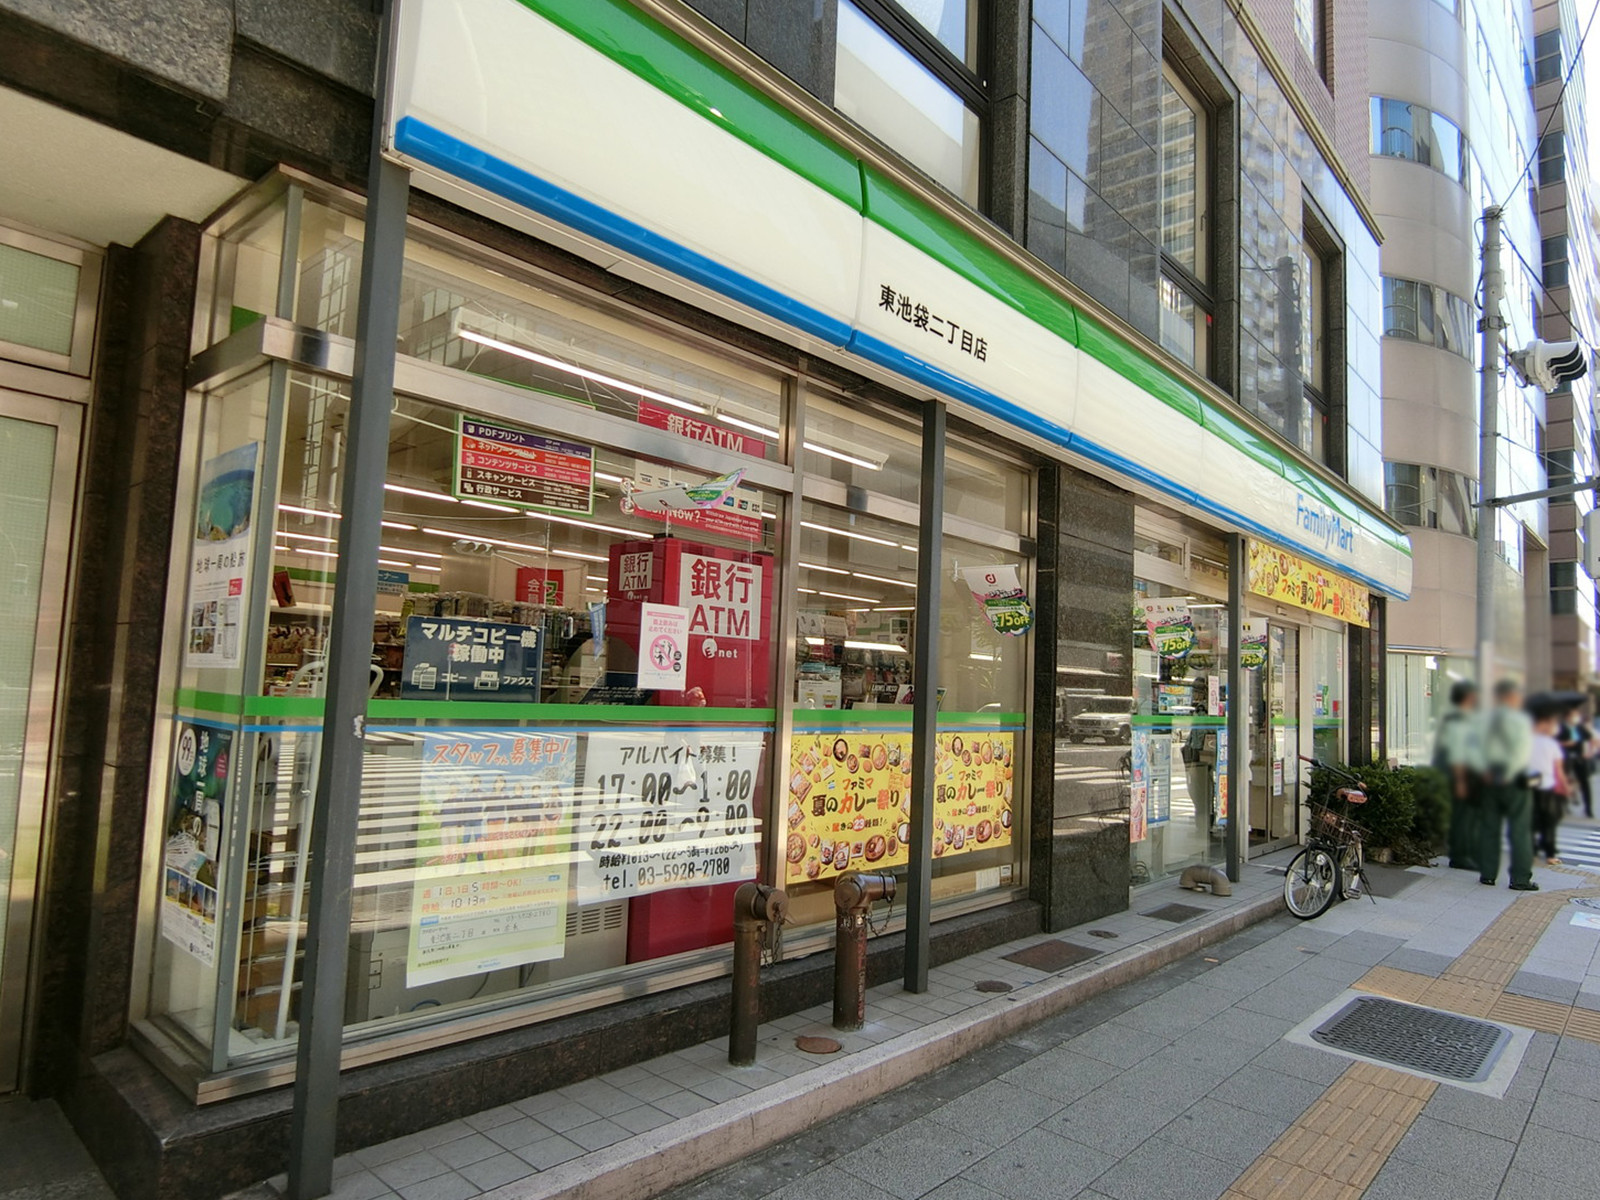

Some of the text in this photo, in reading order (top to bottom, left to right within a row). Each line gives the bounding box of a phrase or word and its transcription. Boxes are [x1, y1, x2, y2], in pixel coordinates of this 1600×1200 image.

[879, 284, 988, 362] 東池袋二丁目店
[478, 427, 526, 443] PDFプリント
[667, 413, 743, 453] 銀行ATM
[477, 456, 538, 473] コンテンツサービス
[477, 470, 536, 487] スキャンサービス
[476, 484, 522, 498] 行政サービス
[1296, 493, 1353, 553] FamilyMart
[623, 554, 649, 574] 銀行
[622, 575, 648, 590] ATM
[690, 558, 753, 604] 銀行
[688, 604, 750, 637] ATM
[421, 623, 537, 648] マルチコピー機
[453, 644, 505, 664] 稼働中
[441, 673, 468, 683] コピー
[503, 675, 535, 687] ファクス
[842, 777, 874, 790] ファミマ
[959, 770, 983, 781] ファミマ
[936, 781, 1003, 803] 夏のカレー祭り
[811, 789, 900, 817] 夏のカレー祭り
